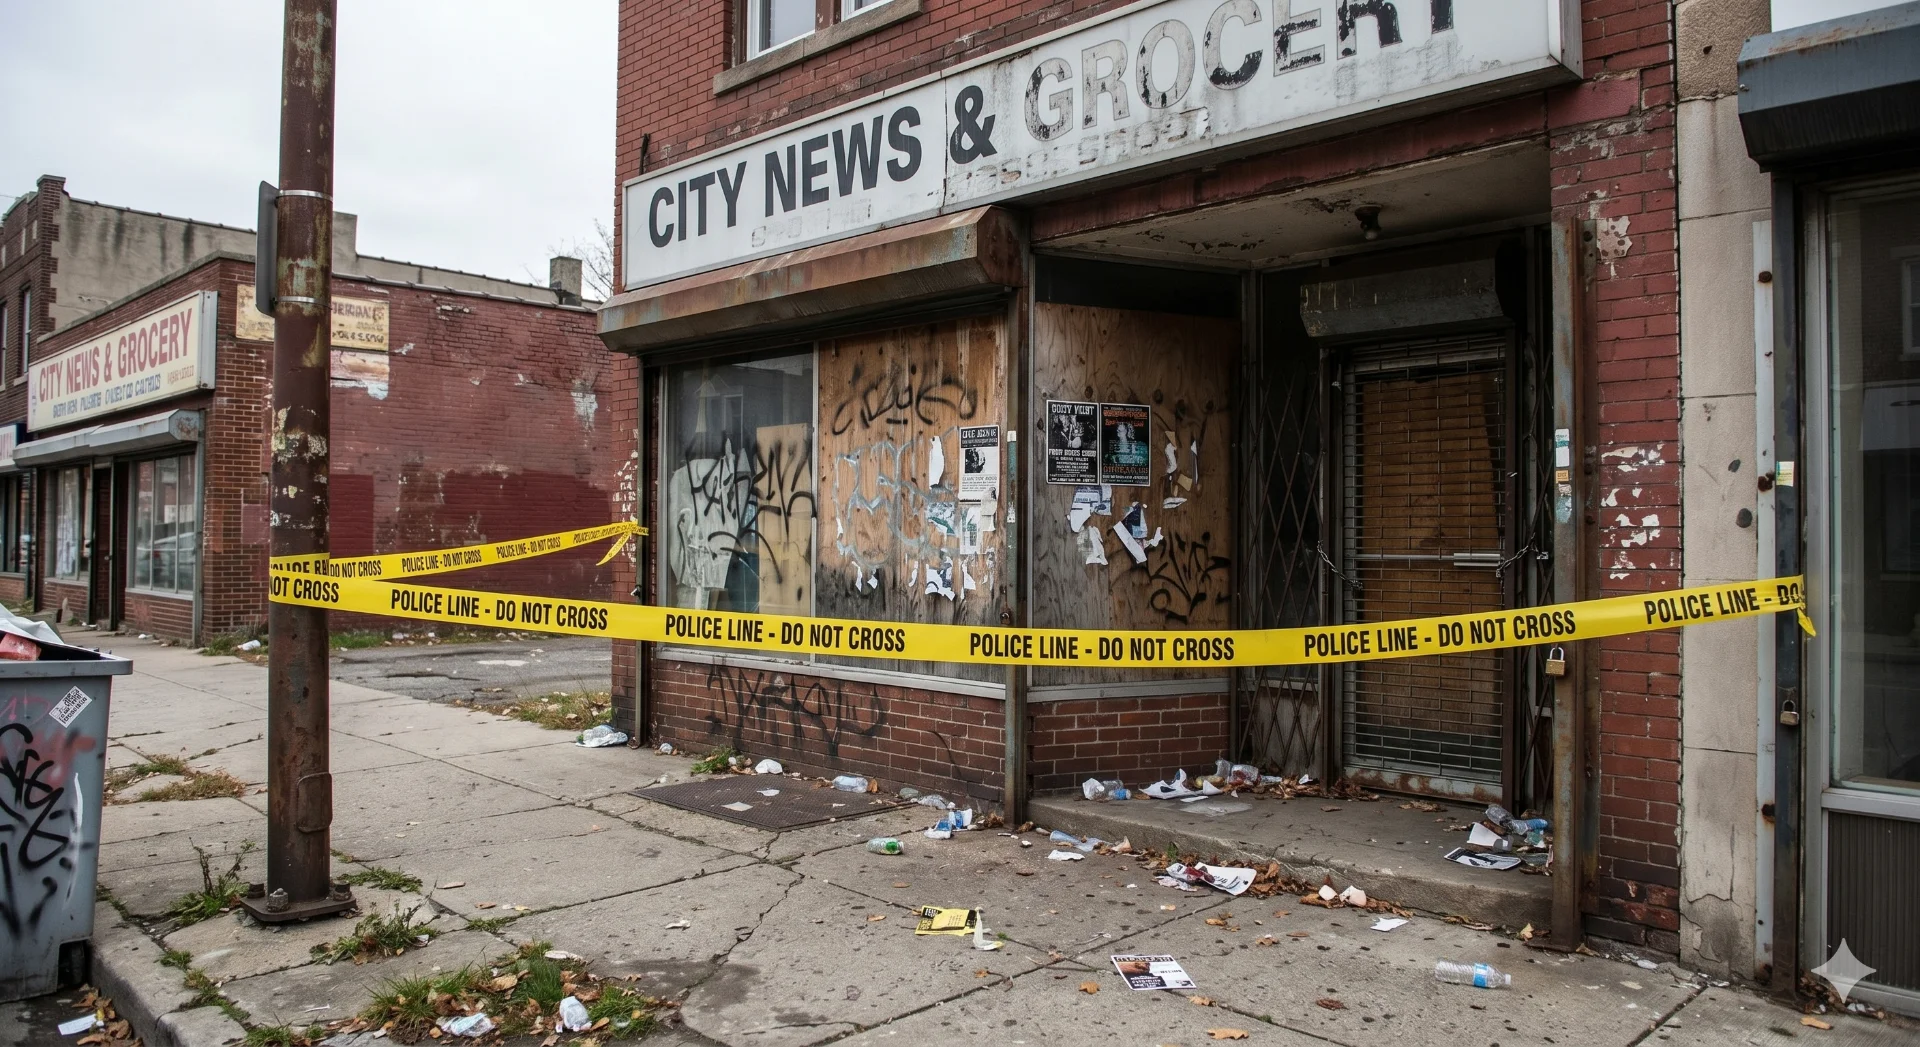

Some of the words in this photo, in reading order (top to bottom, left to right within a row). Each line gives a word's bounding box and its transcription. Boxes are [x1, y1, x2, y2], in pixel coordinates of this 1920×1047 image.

[649, 161, 747, 248] CITY
[764, 106, 922, 218] NEWS
[949, 85, 998, 164] &
[39, 360, 63, 402] CITY
[66, 346, 100, 395] NEWS
[103, 341, 112, 383] &
[118, 308, 192, 378] GROCERY
[402, 556, 425, 572] POLICE
[425, 555, 439, 570] LINE
[443, 554, 451, 567] DO
[452, 552, 464, 566] NOT
[464, 550, 482, 565] CROSS
[496, 545, 516, 559] POLICE
[515, 543, 527, 556] LINE
[530, 541, 537, 554] DO
[537, 539, 547, 552] NOT
[547, 536, 561, 550] CROSS
[342, 562, 356, 578] NOT
[358, 560, 382, 577] CROSS
[293, 578, 339, 603] CROSS
[1644, 593, 1715, 625] POLICE
[1716, 587, 1760, 616] LINE
[1776, 582, 1799, 606] DO
[391, 589, 442, 615] POLICE
[447, 595, 479, 618] LINE
[496, 600, 516, 622] DO
[521, 602, 552, 625] NOT
[556, 604, 608, 631] CROSS
[665, 614, 722, 640] POLICE
[728, 619, 763, 642] LINE
[781, 622, 804, 646] DO
[810, 624, 843, 648] NOT
[848, 626, 906, 652] CROSS
[970, 632, 1033, 659] POLICE
[1039, 636, 1079, 660] LINE
[1099, 637, 1124, 661] DO
[1130, 638, 1167, 661] NOT
[1172, 637, 1235, 661] CROSS
[1304, 630, 1370, 657] POLICE
[1377, 626, 1418, 653] LINE
[1438, 621, 1464, 647] DO
[1469, 618, 1507, 645] NOT
[1513, 609, 1576, 640] CROSS
